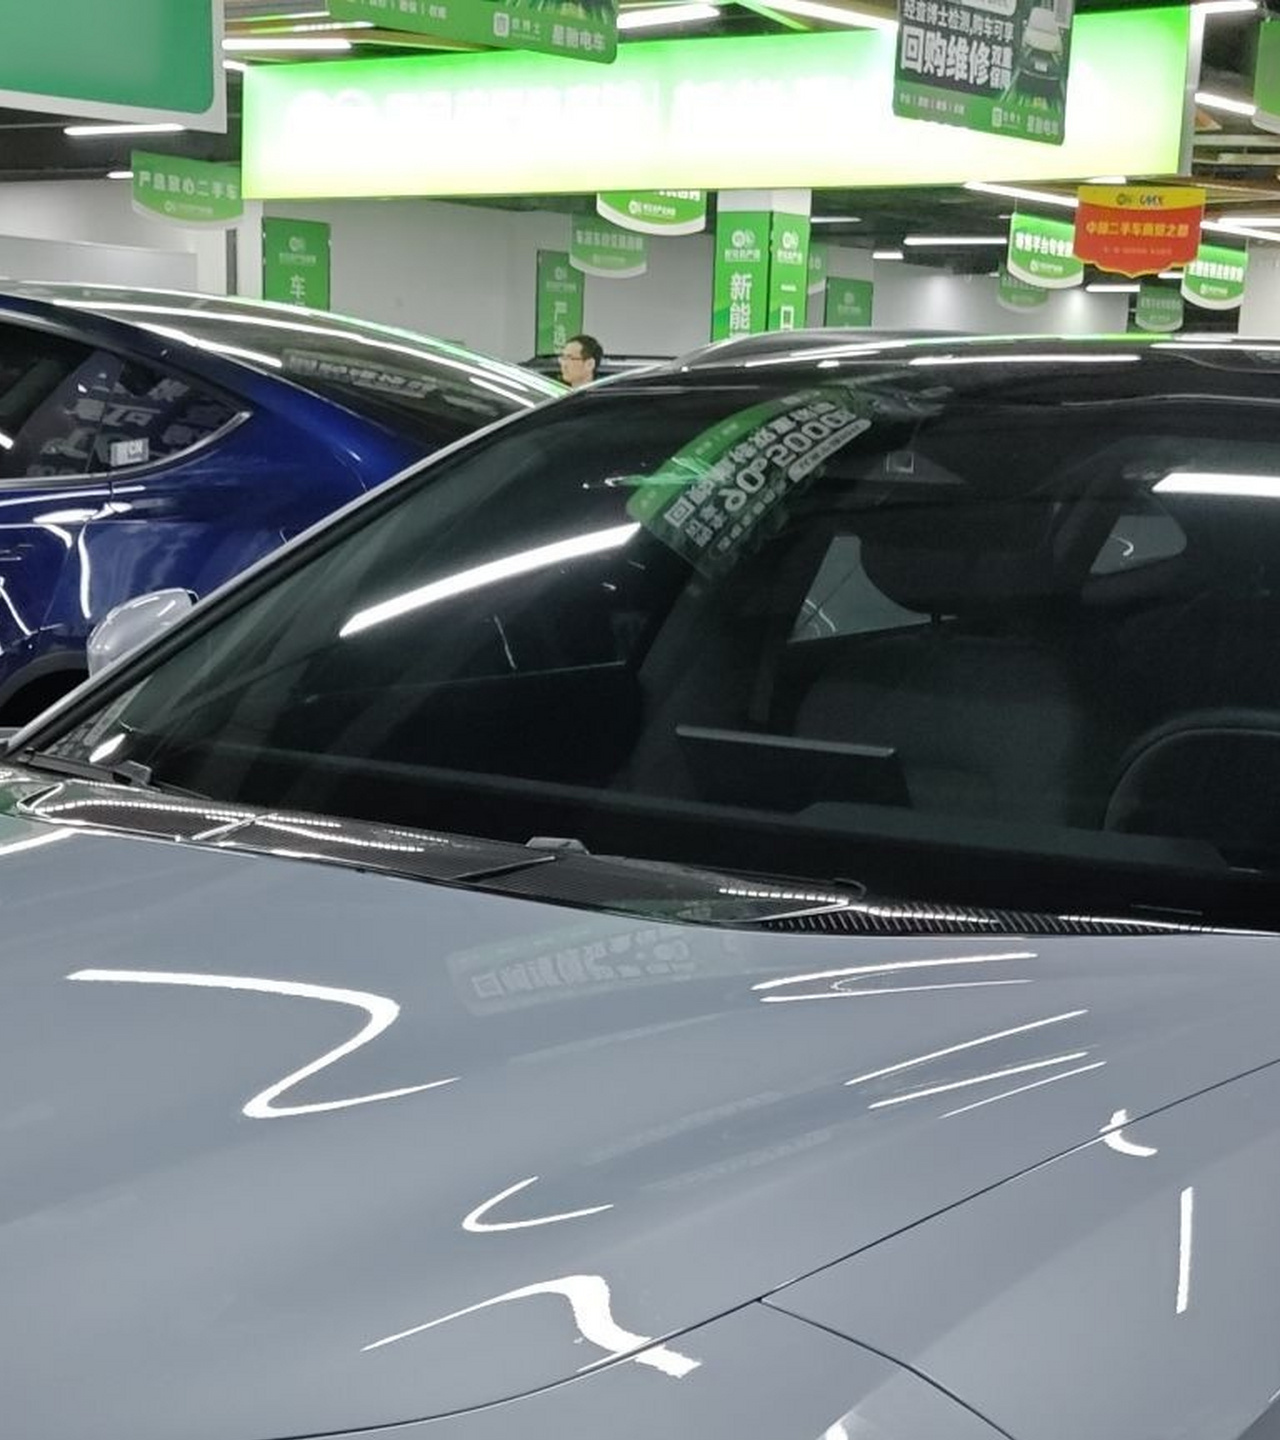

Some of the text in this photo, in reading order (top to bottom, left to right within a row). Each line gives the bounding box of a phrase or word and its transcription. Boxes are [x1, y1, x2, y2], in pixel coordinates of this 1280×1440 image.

[901, 24, 990, 85] 回购维修
[729, 271, 752, 337] 新能
